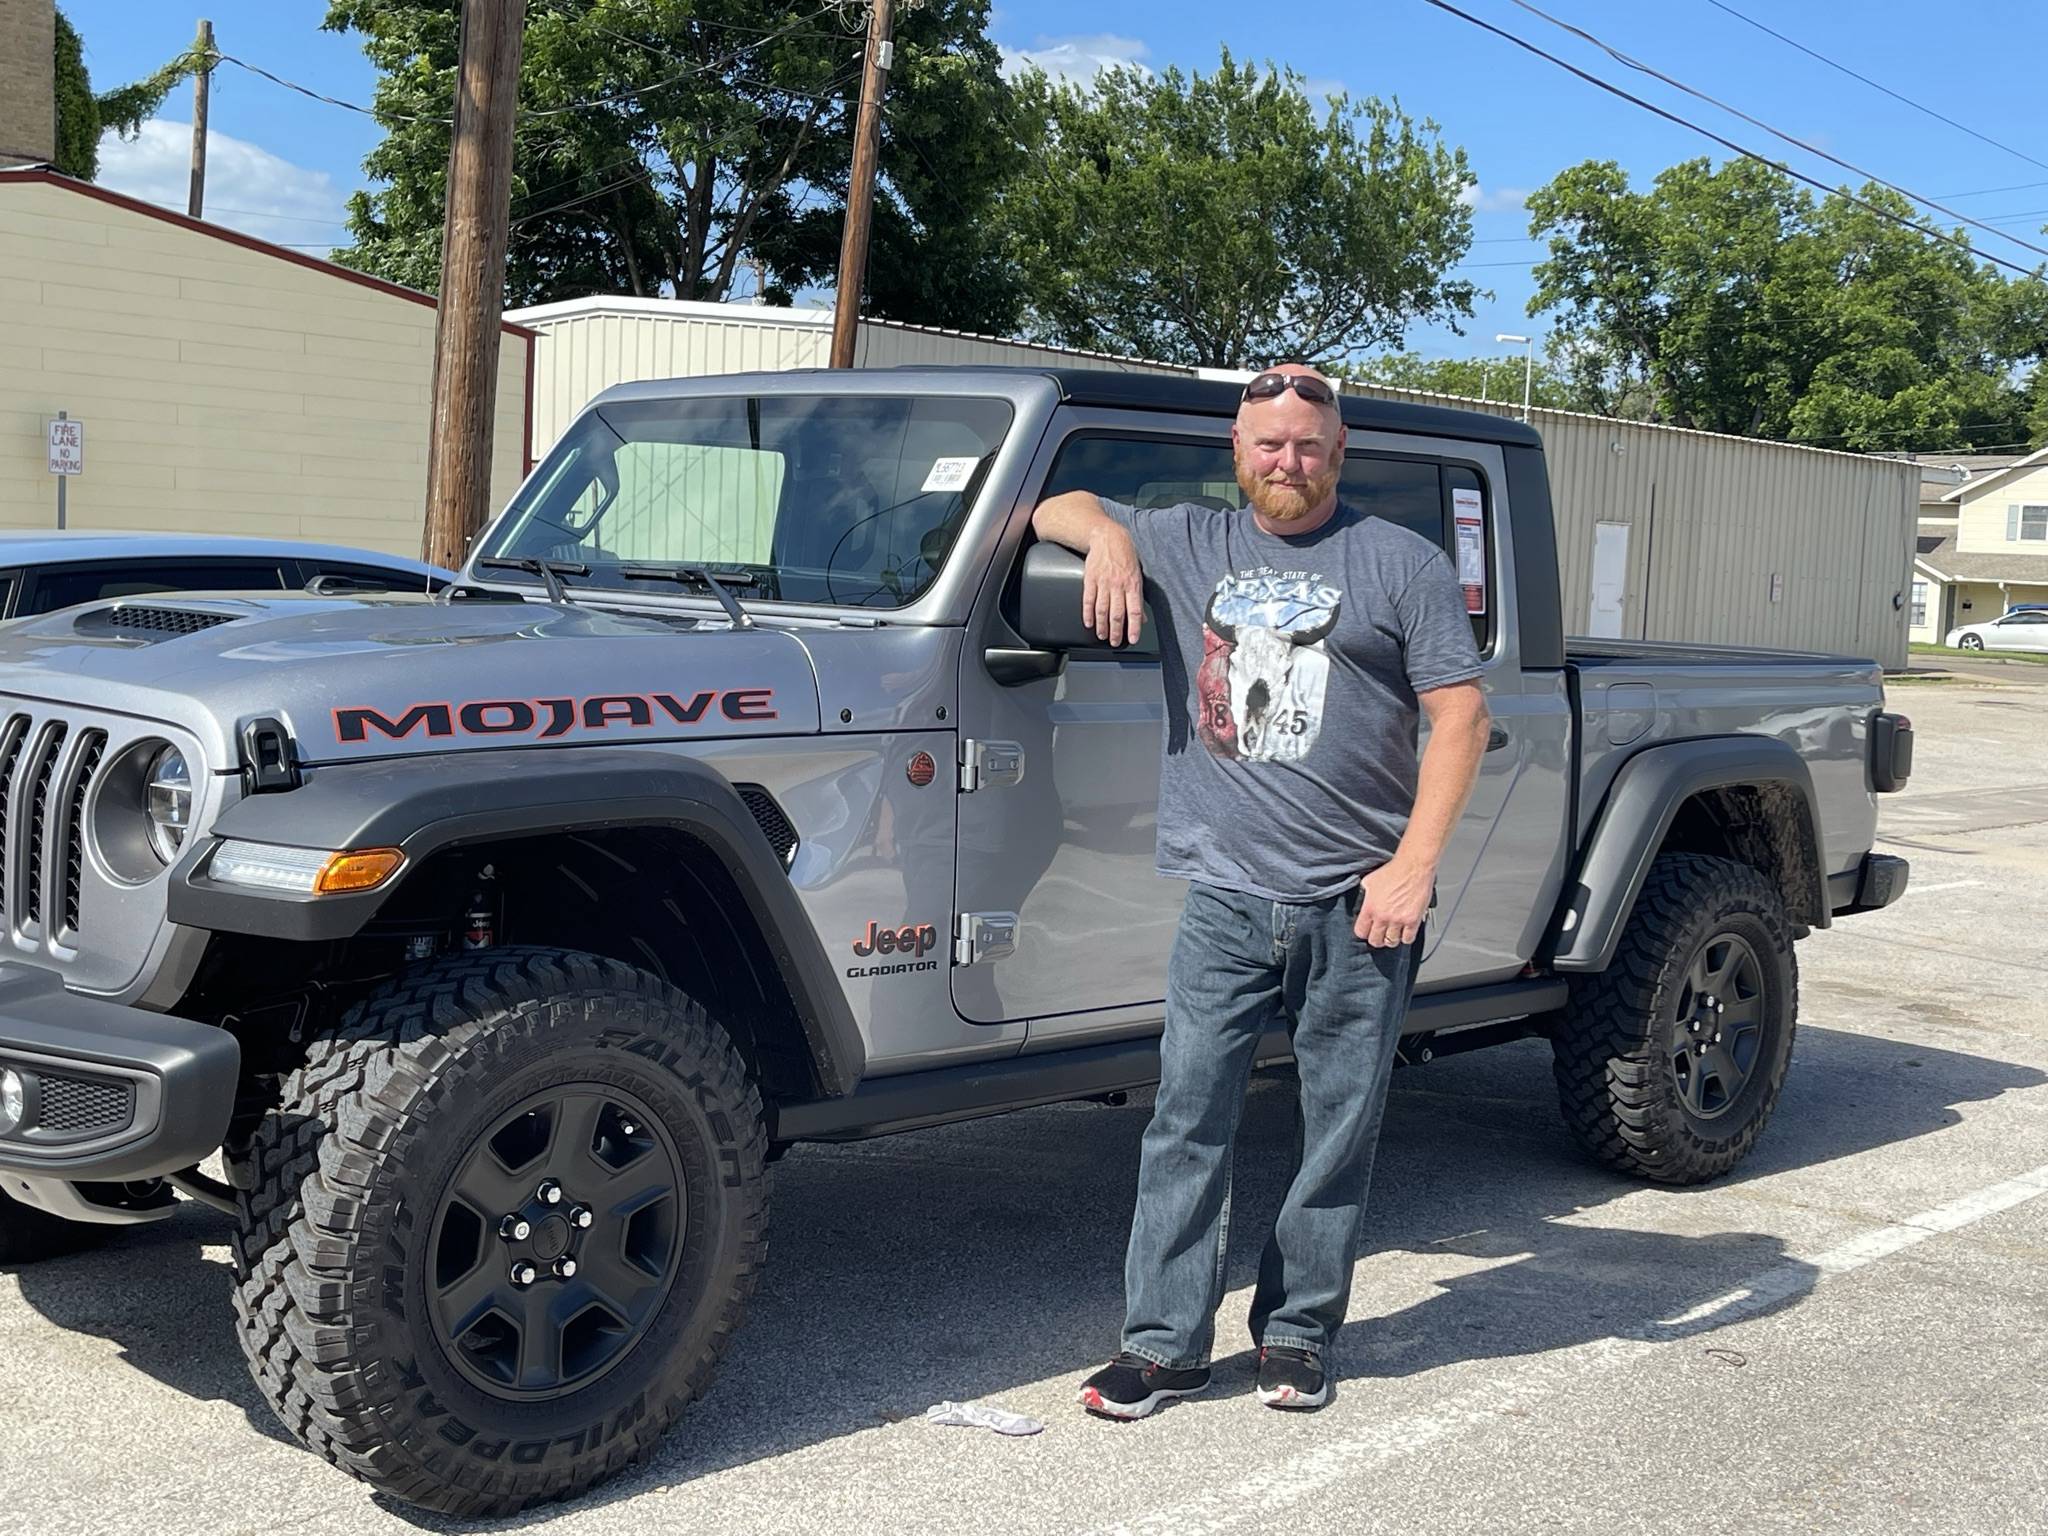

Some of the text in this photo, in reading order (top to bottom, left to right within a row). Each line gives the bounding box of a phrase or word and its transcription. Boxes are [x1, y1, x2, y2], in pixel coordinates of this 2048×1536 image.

[52, 435, 79, 447] LANE
[55, 424, 76, 436] FIRE
[51, 459, 80, 471] PARKING
[60, 448, 70, 459] NO
[1239, 569, 1254, 579] THE
[1282, 570, 1308, 580] STATE
[1311, 573, 1324, 581] OF
[1215, 574, 1343, 609] TEXAS
[332, 689, 778, 743] MOJAVE
[1206, 700, 1228, 729] 18
[1273, 708, 1309, 736] 45
[852, 920, 936, 957] Jeep
[847, 961, 937, 978] GLADIATOR
[592, 1027, 742, 1188] FALKEN
[393, 1354, 648, 1464] WILDPEAK
